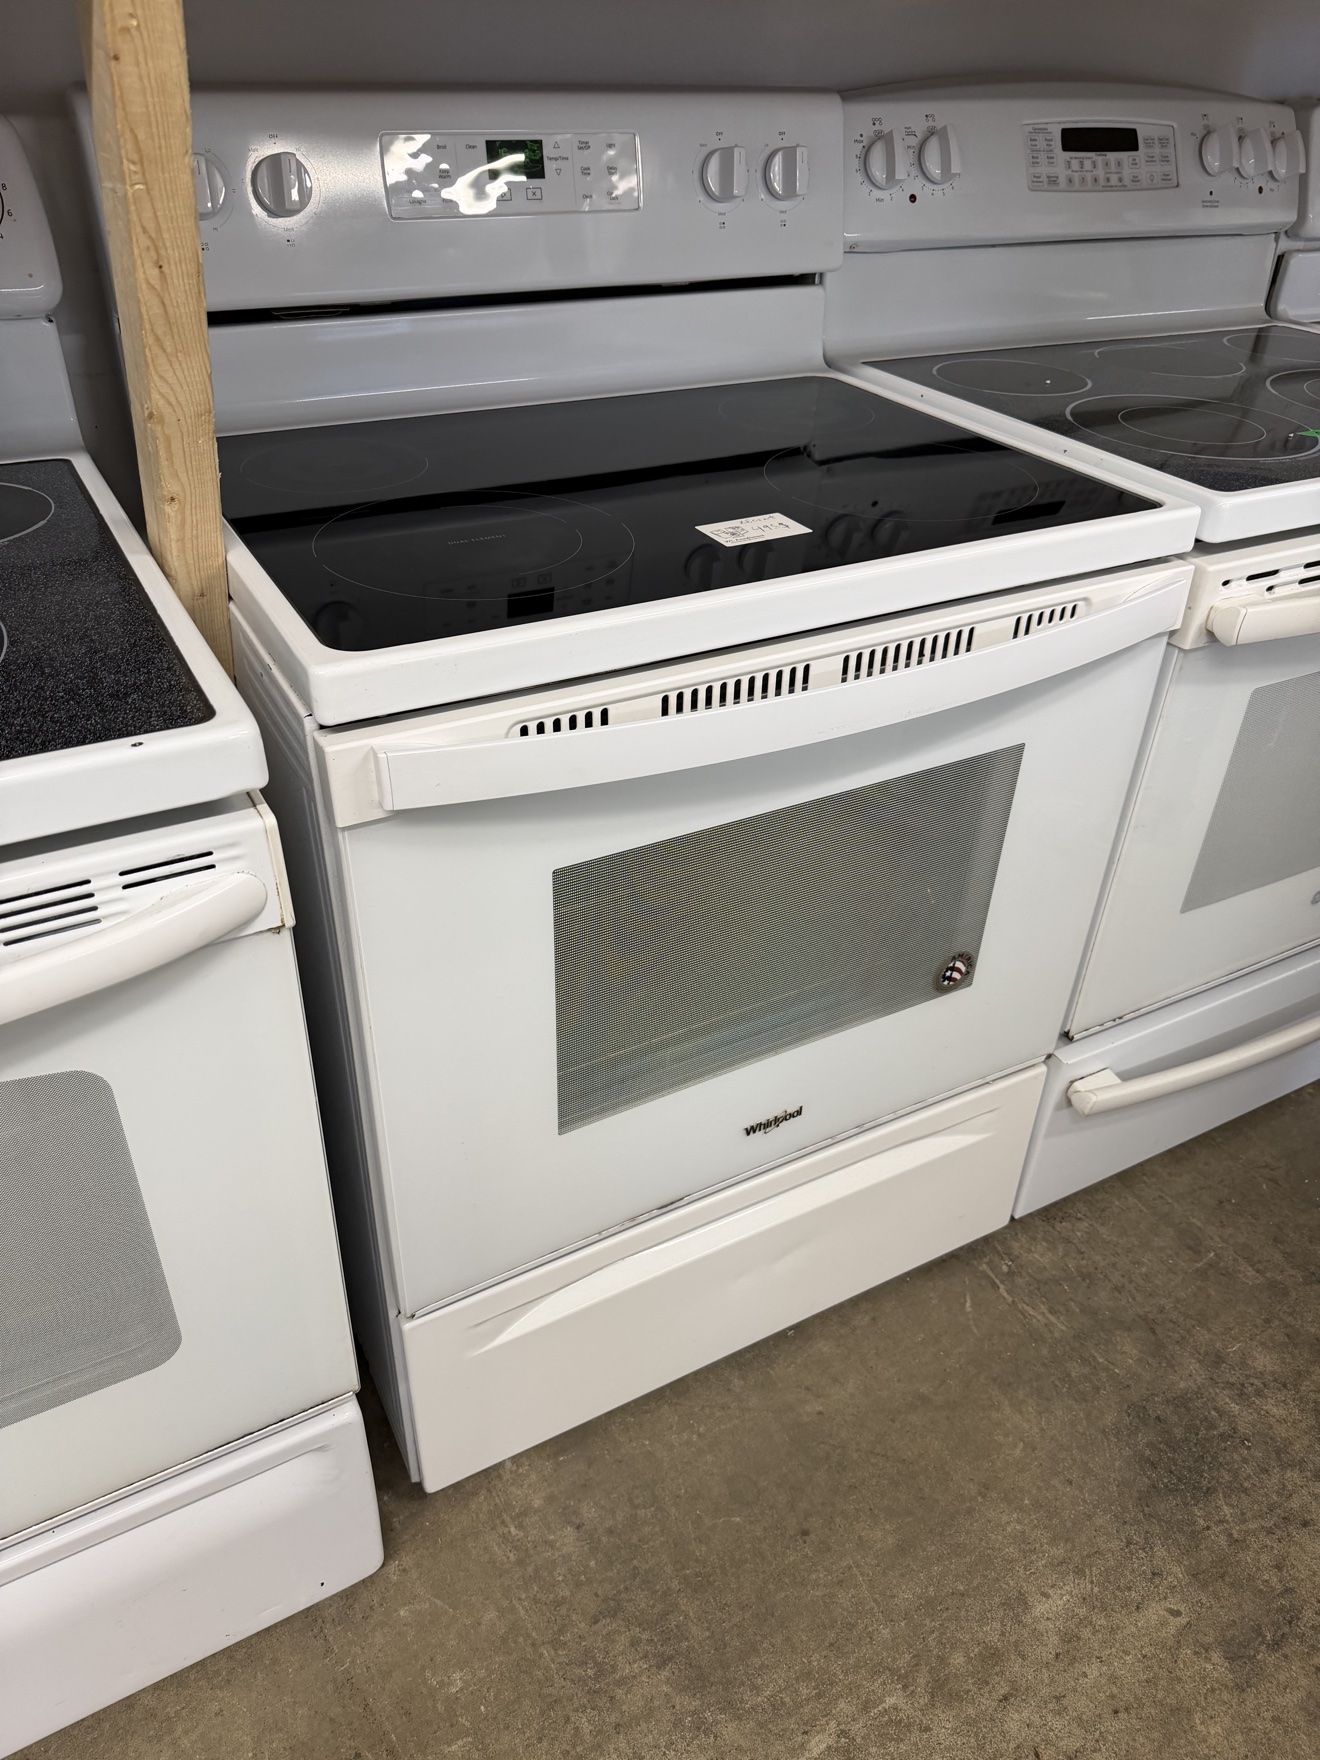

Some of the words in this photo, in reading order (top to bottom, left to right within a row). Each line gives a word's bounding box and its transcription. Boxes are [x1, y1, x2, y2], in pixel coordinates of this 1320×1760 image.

[1, 183, 7, 191] 8
[7, 209, 13, 217] 6
[471, 534, 506, 542] ELEMENT
[950, 952, 973, 976] AMERICA
[743, 1105, 803, 1137] Whirlpool
